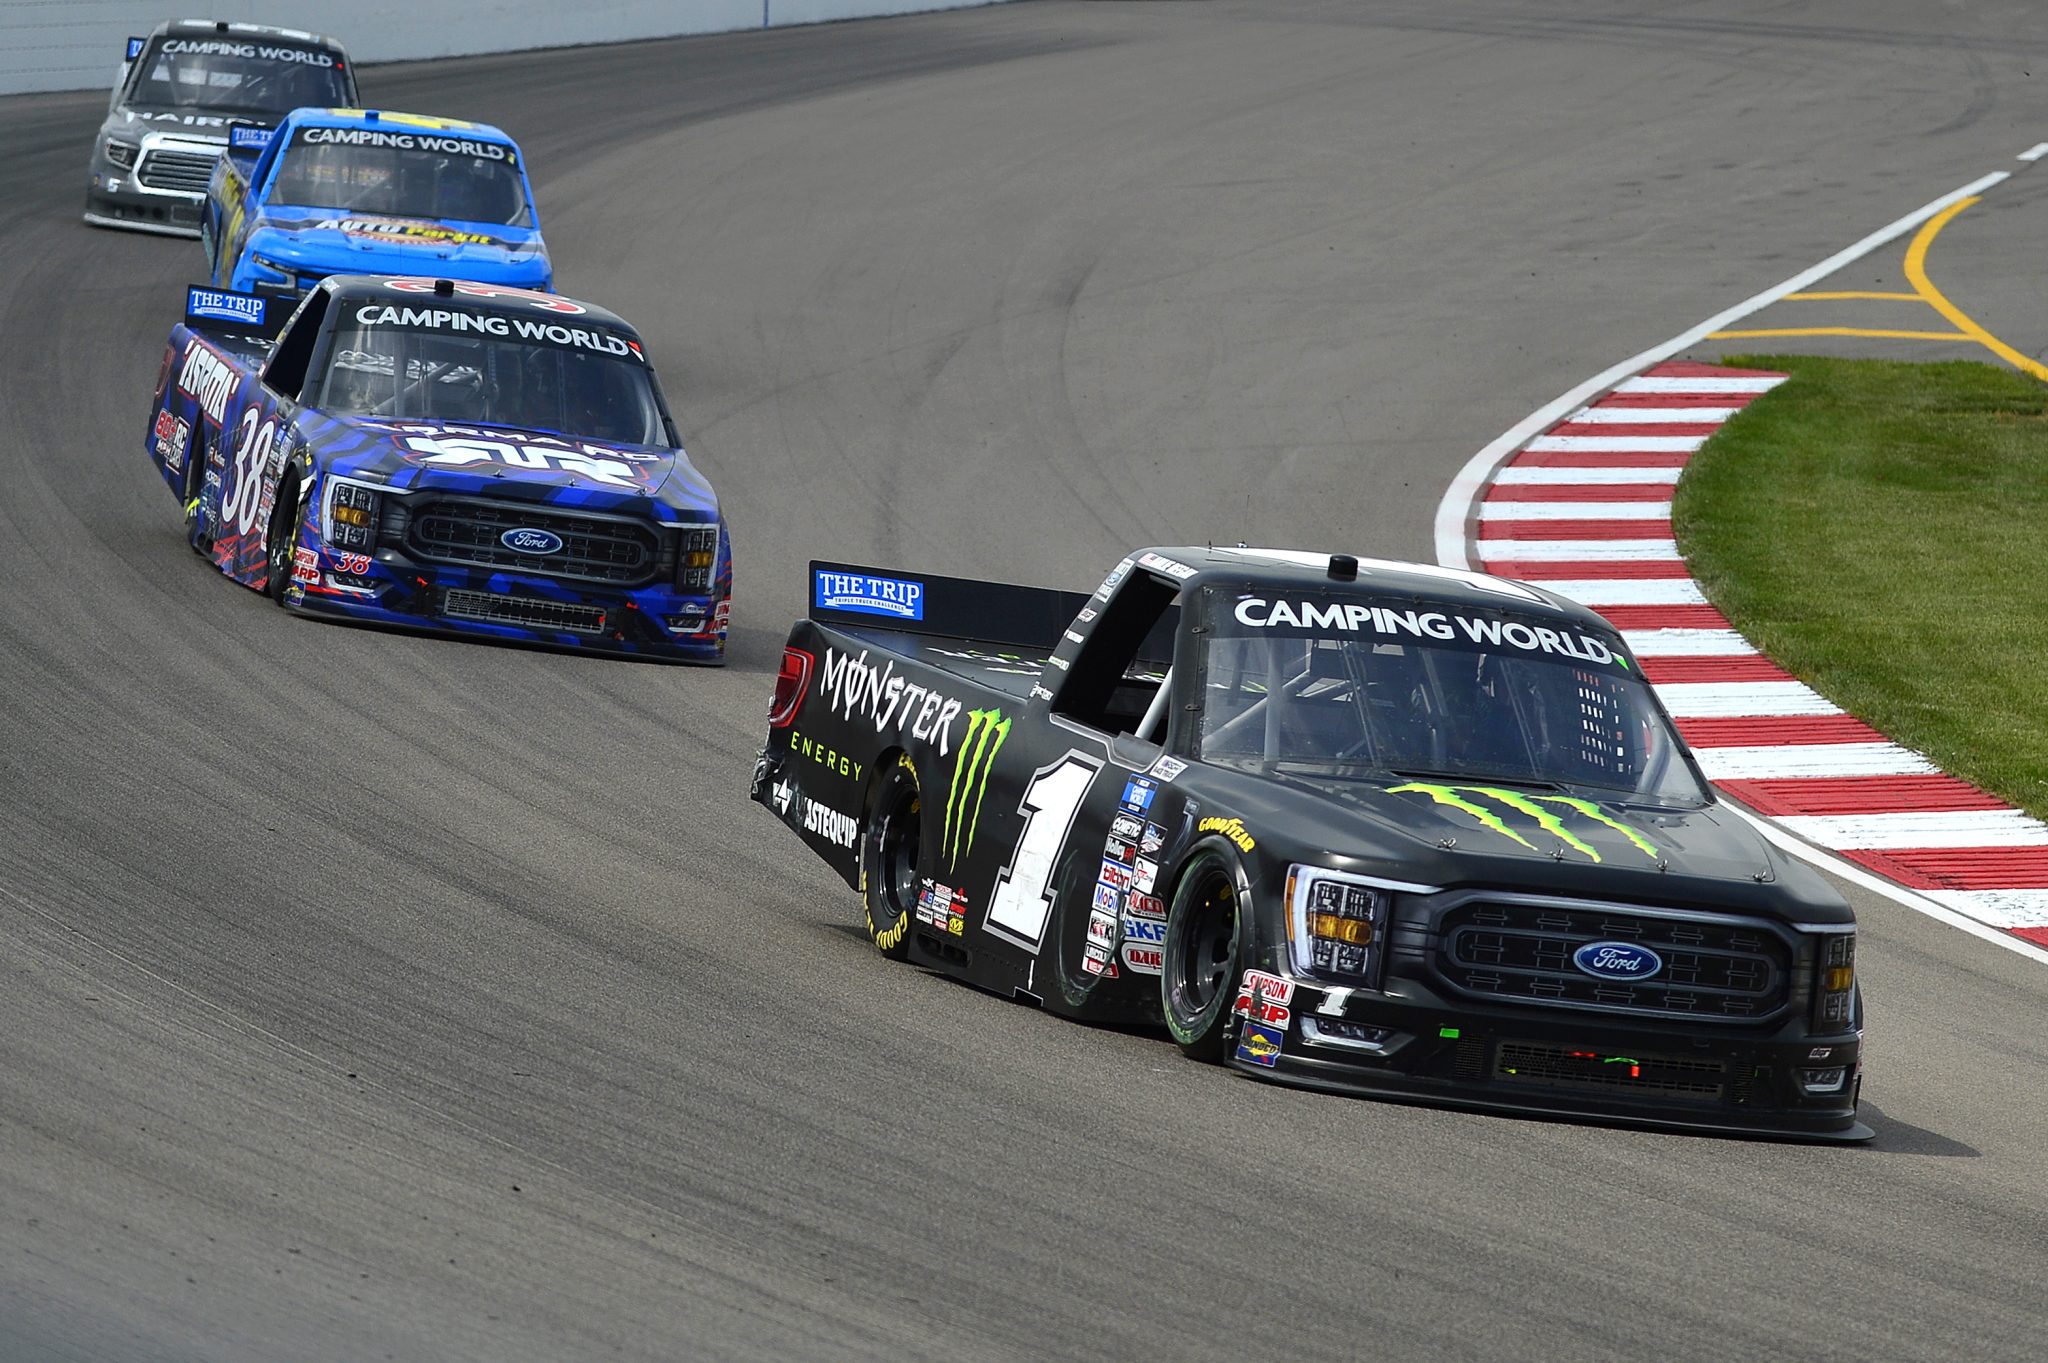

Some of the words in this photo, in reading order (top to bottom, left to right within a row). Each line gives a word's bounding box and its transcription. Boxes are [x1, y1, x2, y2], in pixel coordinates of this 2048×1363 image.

[162, 40, 255, 58] CAMPING
[258, 47, 333, 68] WORLD
[303, 128, 414, 149] CAMPING
[418, 136, 504, 160] WORLD
[192, 290, 223, 307] THE
[225, 295, 263, 316] TRIP
[356, 305, 510, 336] CAMPING
[515, 320, 628, 357] WORLD
[222, 408, 275, 536] 38
[514, 531, 548, 549] Ford
[292, 565, 318, 580] ARP
[335, 551, 372, 575] 38
[819, 573, 863, 596] THE
[867, 578, 920, 607] TRIP
[1234, 599, 1455, 640] CAMPING
[1455, 615, 1613, 666] WORLD
[790, 731, 862, 782] ENERGY
[803, 797, 859, 849] ASTEQUIP
[1199, 817, 1255, 853] GOODYEAR
[983, 749, 1105, 954] 1
[1129, 948, 1162, 966] DAR
[1593, 947, 1642, 971] Ford
[1315, 985, 1355, 1017] 1
